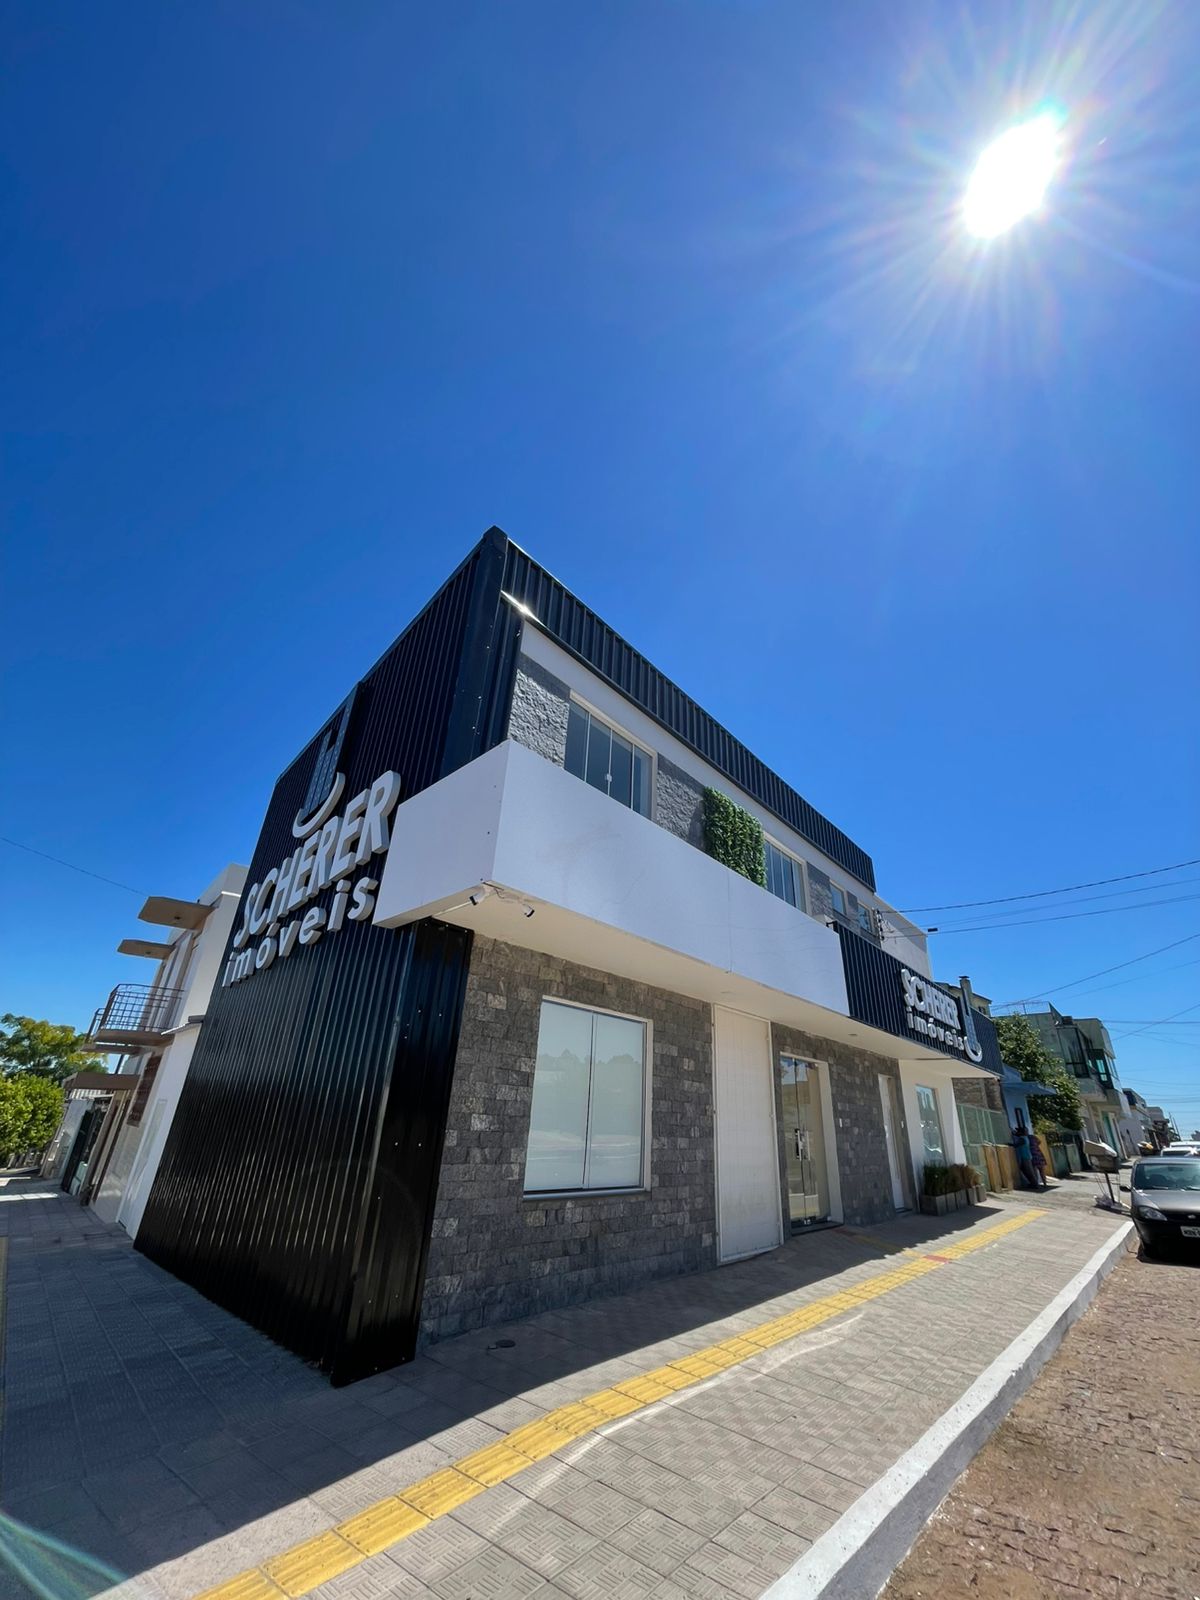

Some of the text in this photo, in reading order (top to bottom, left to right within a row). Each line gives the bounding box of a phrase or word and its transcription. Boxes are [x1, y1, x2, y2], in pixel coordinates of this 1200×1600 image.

[234, 770, 401, 948] SCHERER
[223, 876, 378, 987] imóveis
[901, 968, 961, 1030] SCHERER
